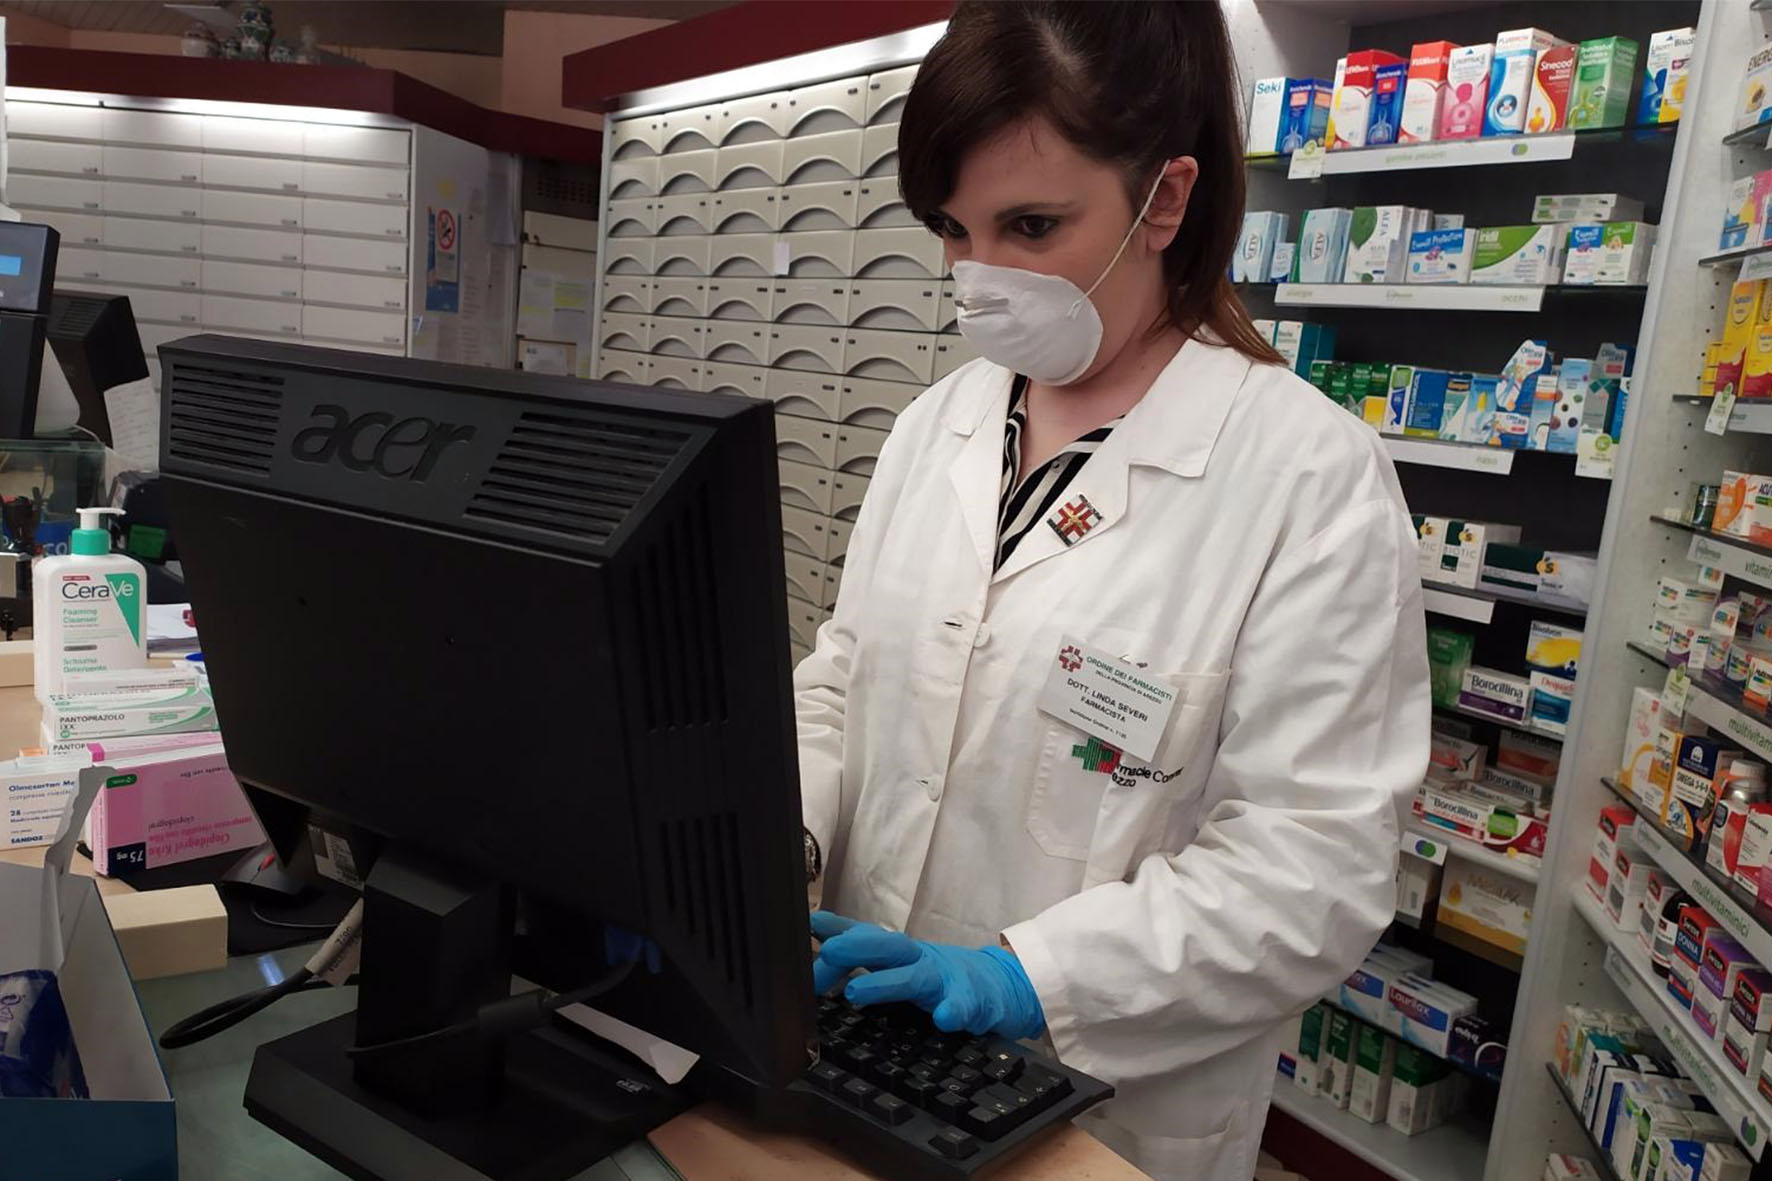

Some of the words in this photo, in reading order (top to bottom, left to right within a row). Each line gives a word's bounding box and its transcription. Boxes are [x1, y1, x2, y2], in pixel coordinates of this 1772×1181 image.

[1256, 82, 1282, 95] Seki
[292, 404, 478, 481] acer
[62, 579, 134, 600] CeraVe
[1086, 656, 1117, 675] ORDINE
[1115, 667, 1127, 680] DEI
[1128, 673, 1173, 701] FARMACISTI
[1471, 674, 1524, 699] Borocillina
[1067, 678, 1091, 696] DOTT.
[1091, 687, 1117, 707] LINDA
[1117, 698, 1148, 723] SEVERI
[1080, 696, 1126, 723] FARMACISTA
[59, 713, 125, 724] PANTOPRAZOLO
[53, 743, 86, 753] PANTOP
[1433, 796, 1479, 821] Borocillina
[11, 835, 43, 844] SANDOZ
[129, 850, 144, 862] 75
